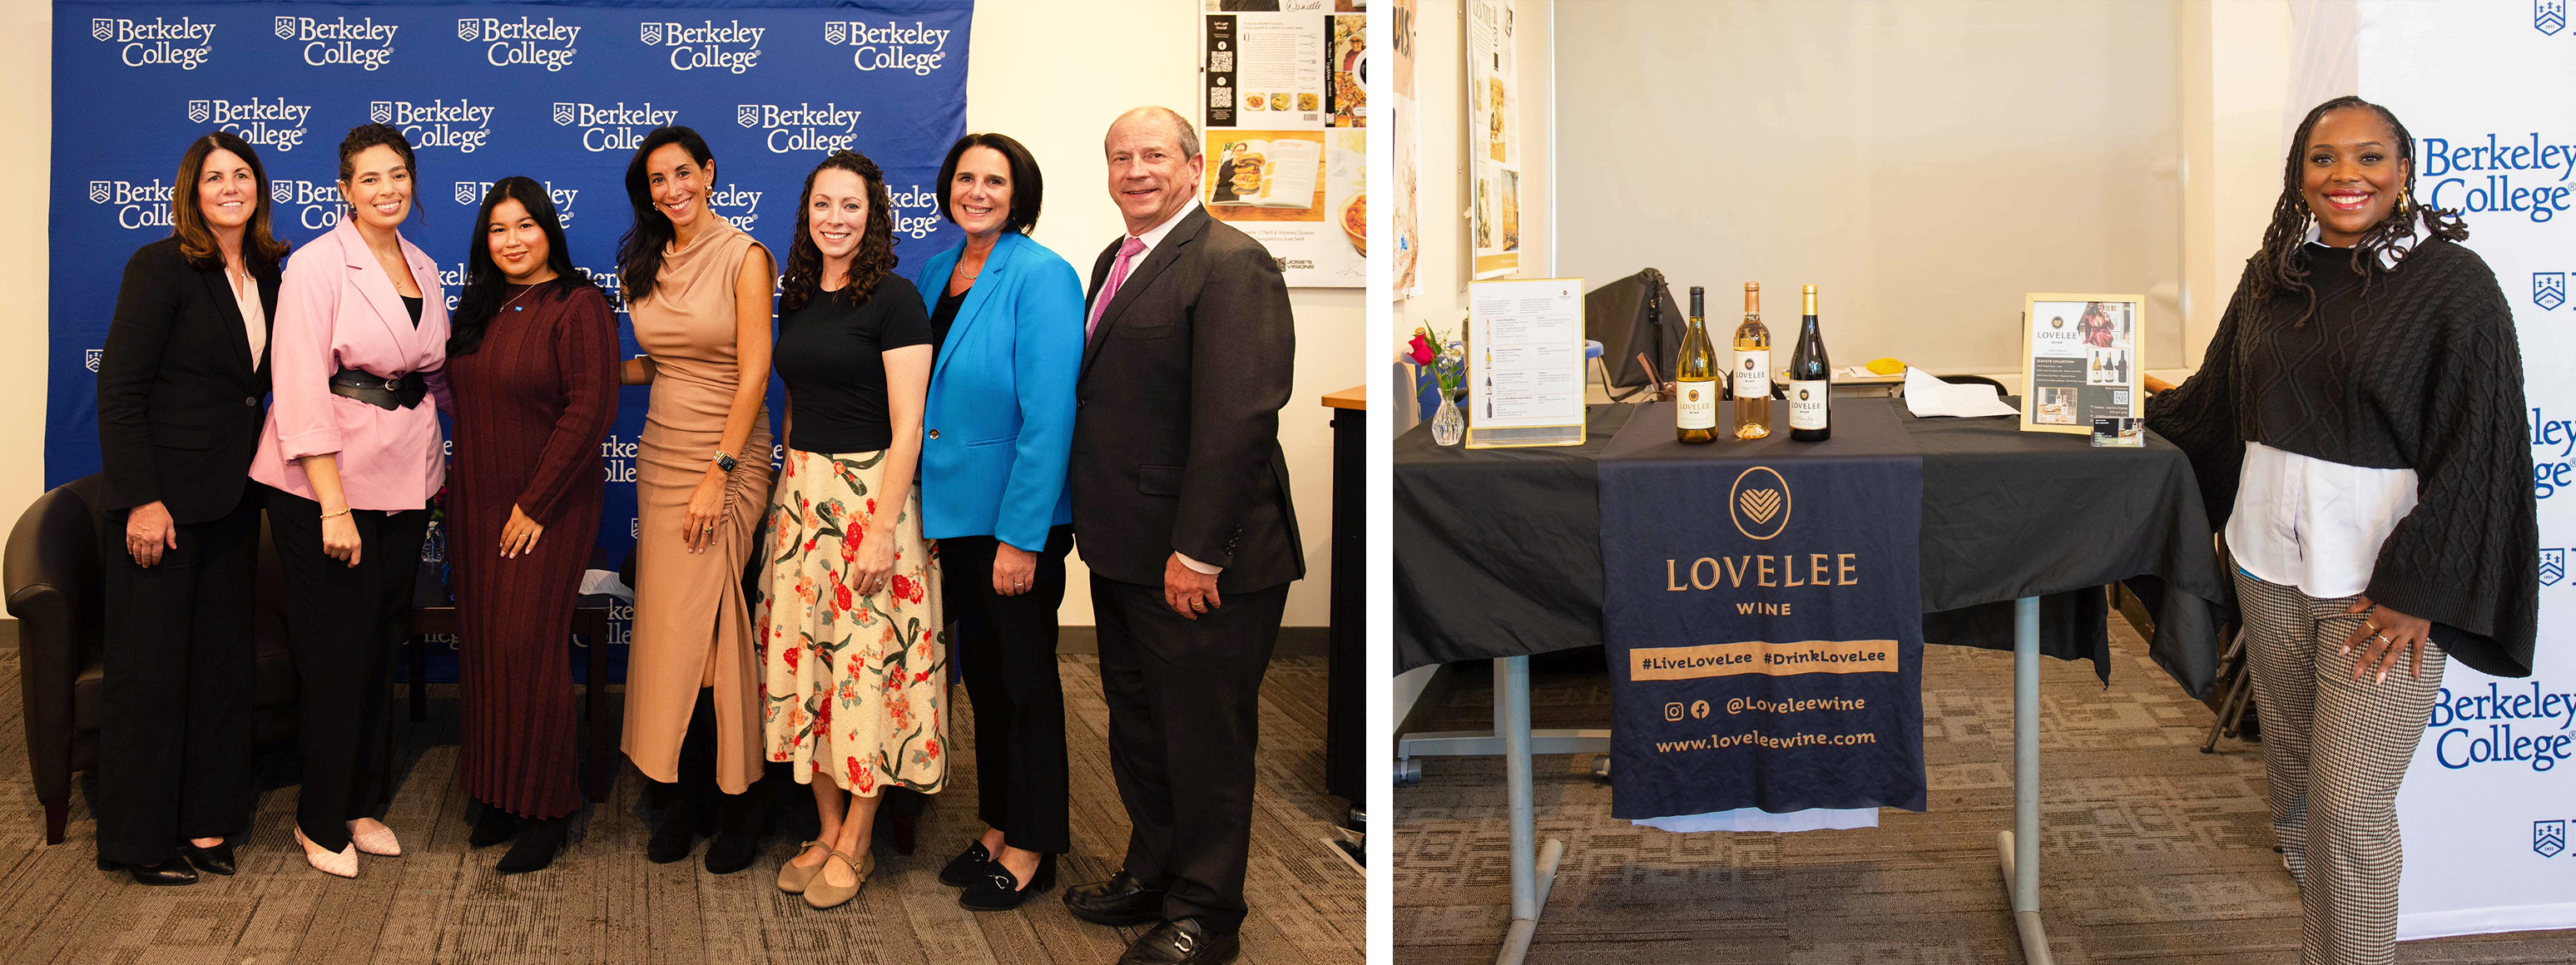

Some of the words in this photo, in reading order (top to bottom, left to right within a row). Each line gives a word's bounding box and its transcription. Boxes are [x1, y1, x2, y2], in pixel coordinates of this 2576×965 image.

[116, 17, 215, 47] Berkeley
[299, 17, 398, 47] Berkeley
[483, 17, 581, 47] Berkeley
[666, 20, 765, 50] Berkeley
[850, 22, 950, 52] Berkeley
[213, 97, 311, 128] Berkeley
[395, 99, 494, 129] Berkeley
[578, 102, 678, 127] Berkeley
[762, 103, 862, 133] Berkeley
[583, 126, 645, 151] Colle
[2423, 132, 2576, 181] Berkeley
[114, 179, 176, 204] Berke
[119, 204, 176, 229] Colle
[1667, 553, 1859, 591] LOVELEE
[1736, 602, 1791, 616] WINE
[1642, 652, 1752, 671] #LiveLoveLee
[1763, 649, 1885, 666] #DrinkLoveLee
[1726, 696, 1865, 715] @Loveleewine
[2428, 681, 2576, 730] Berkeley
[1656, 730, 1876, 754] www.loveleewine.com
